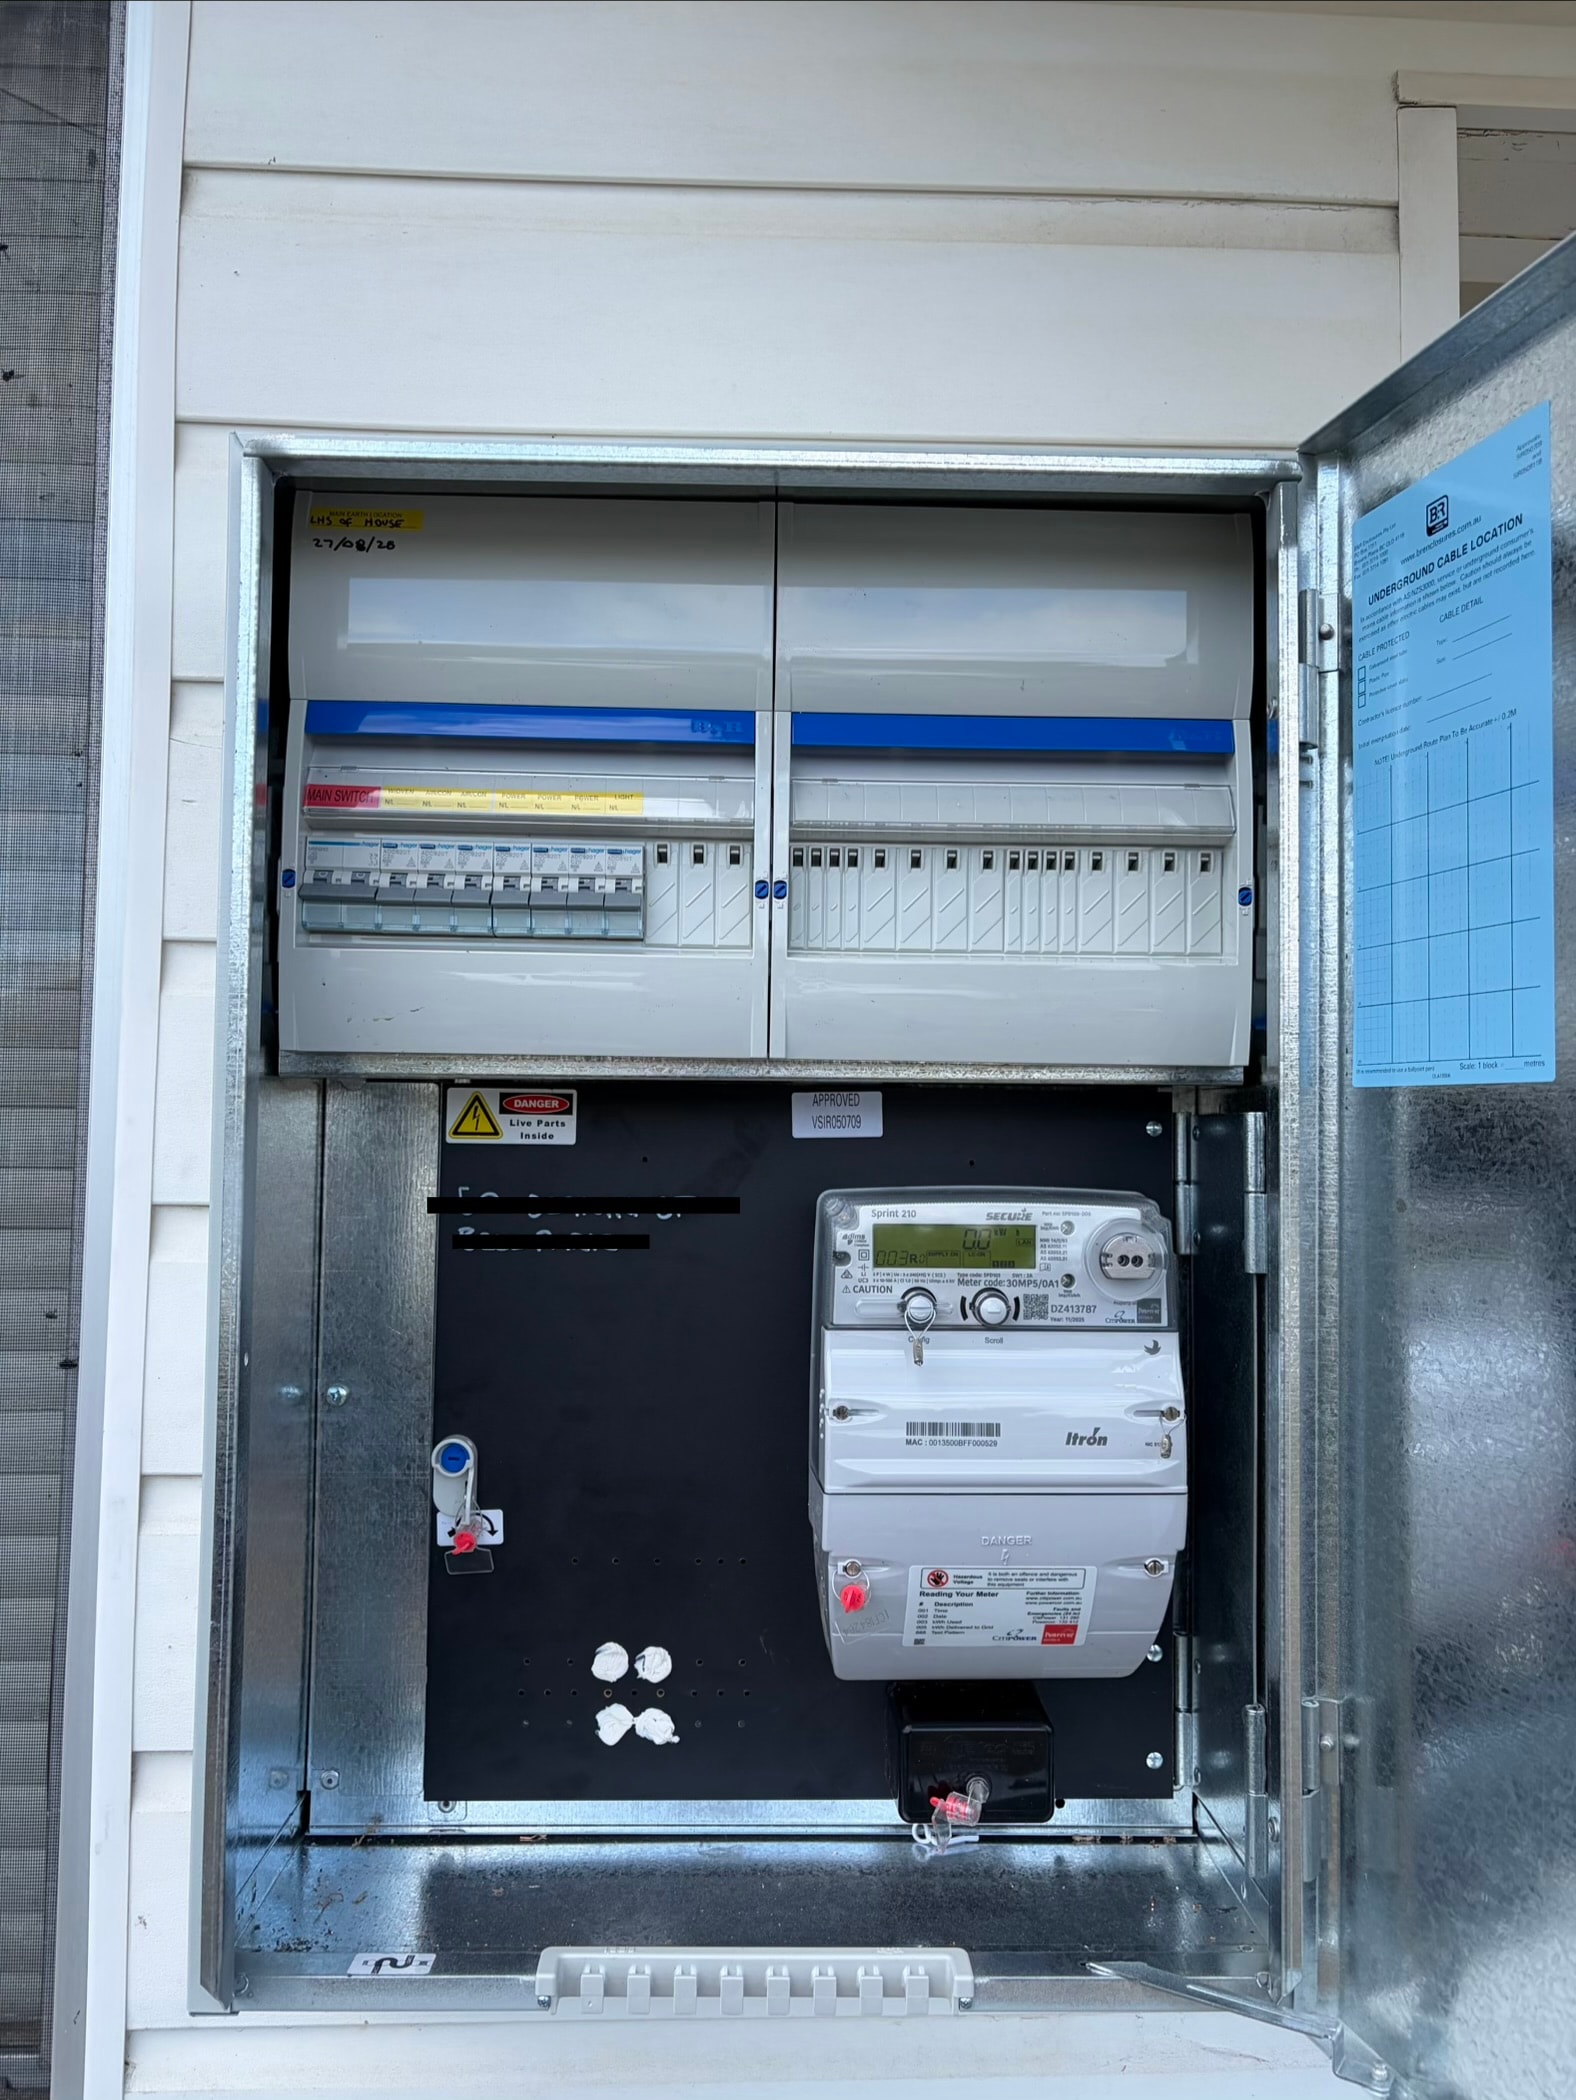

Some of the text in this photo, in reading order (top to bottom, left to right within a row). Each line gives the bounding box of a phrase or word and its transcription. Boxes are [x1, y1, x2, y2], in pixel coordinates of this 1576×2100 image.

[310, 516, 332, 526] LHS
[365, 519, 405, 528] HOUSE
[1368, 562, 1434, 606] UNDERGROUND
[1437, 544, 1468, 569] CABLE
[1470, 513, 1523, 551] LOCATION
[1439, 596, 1483, 623] CABLE DETAIL
[1358, 631, 1410, 661] CABLE PROTECTED
[1424, 738, 1438, 749] Route
[1452, 730, 1459, 738] To
[1460, 727, 1467, 735] Be
[1469, 718, 1493, 732] Accurate
[308, 789, 375, 804] MAIN SWITCH
[514, 1100, 559, 1108] DANGER
[812, 1093, 860, 1107] APPROVED
[509, 1119, 566, 1127] Live Parts
[812, 1115, 861, 1129] VSIR050709
[520, 1132, 554, 1140] Inside
[872, 1209, 916, 1218] Sprint 210
[986, 1210, 1032, 1221] SECURE
[958, 1278, 981, 1286] Meter
[1051, 1304, 1097, 1313] DZ413787
[1065, 1427, 1108, 1447] Itron
[982, 1536, 1032, 1546] DANGER
